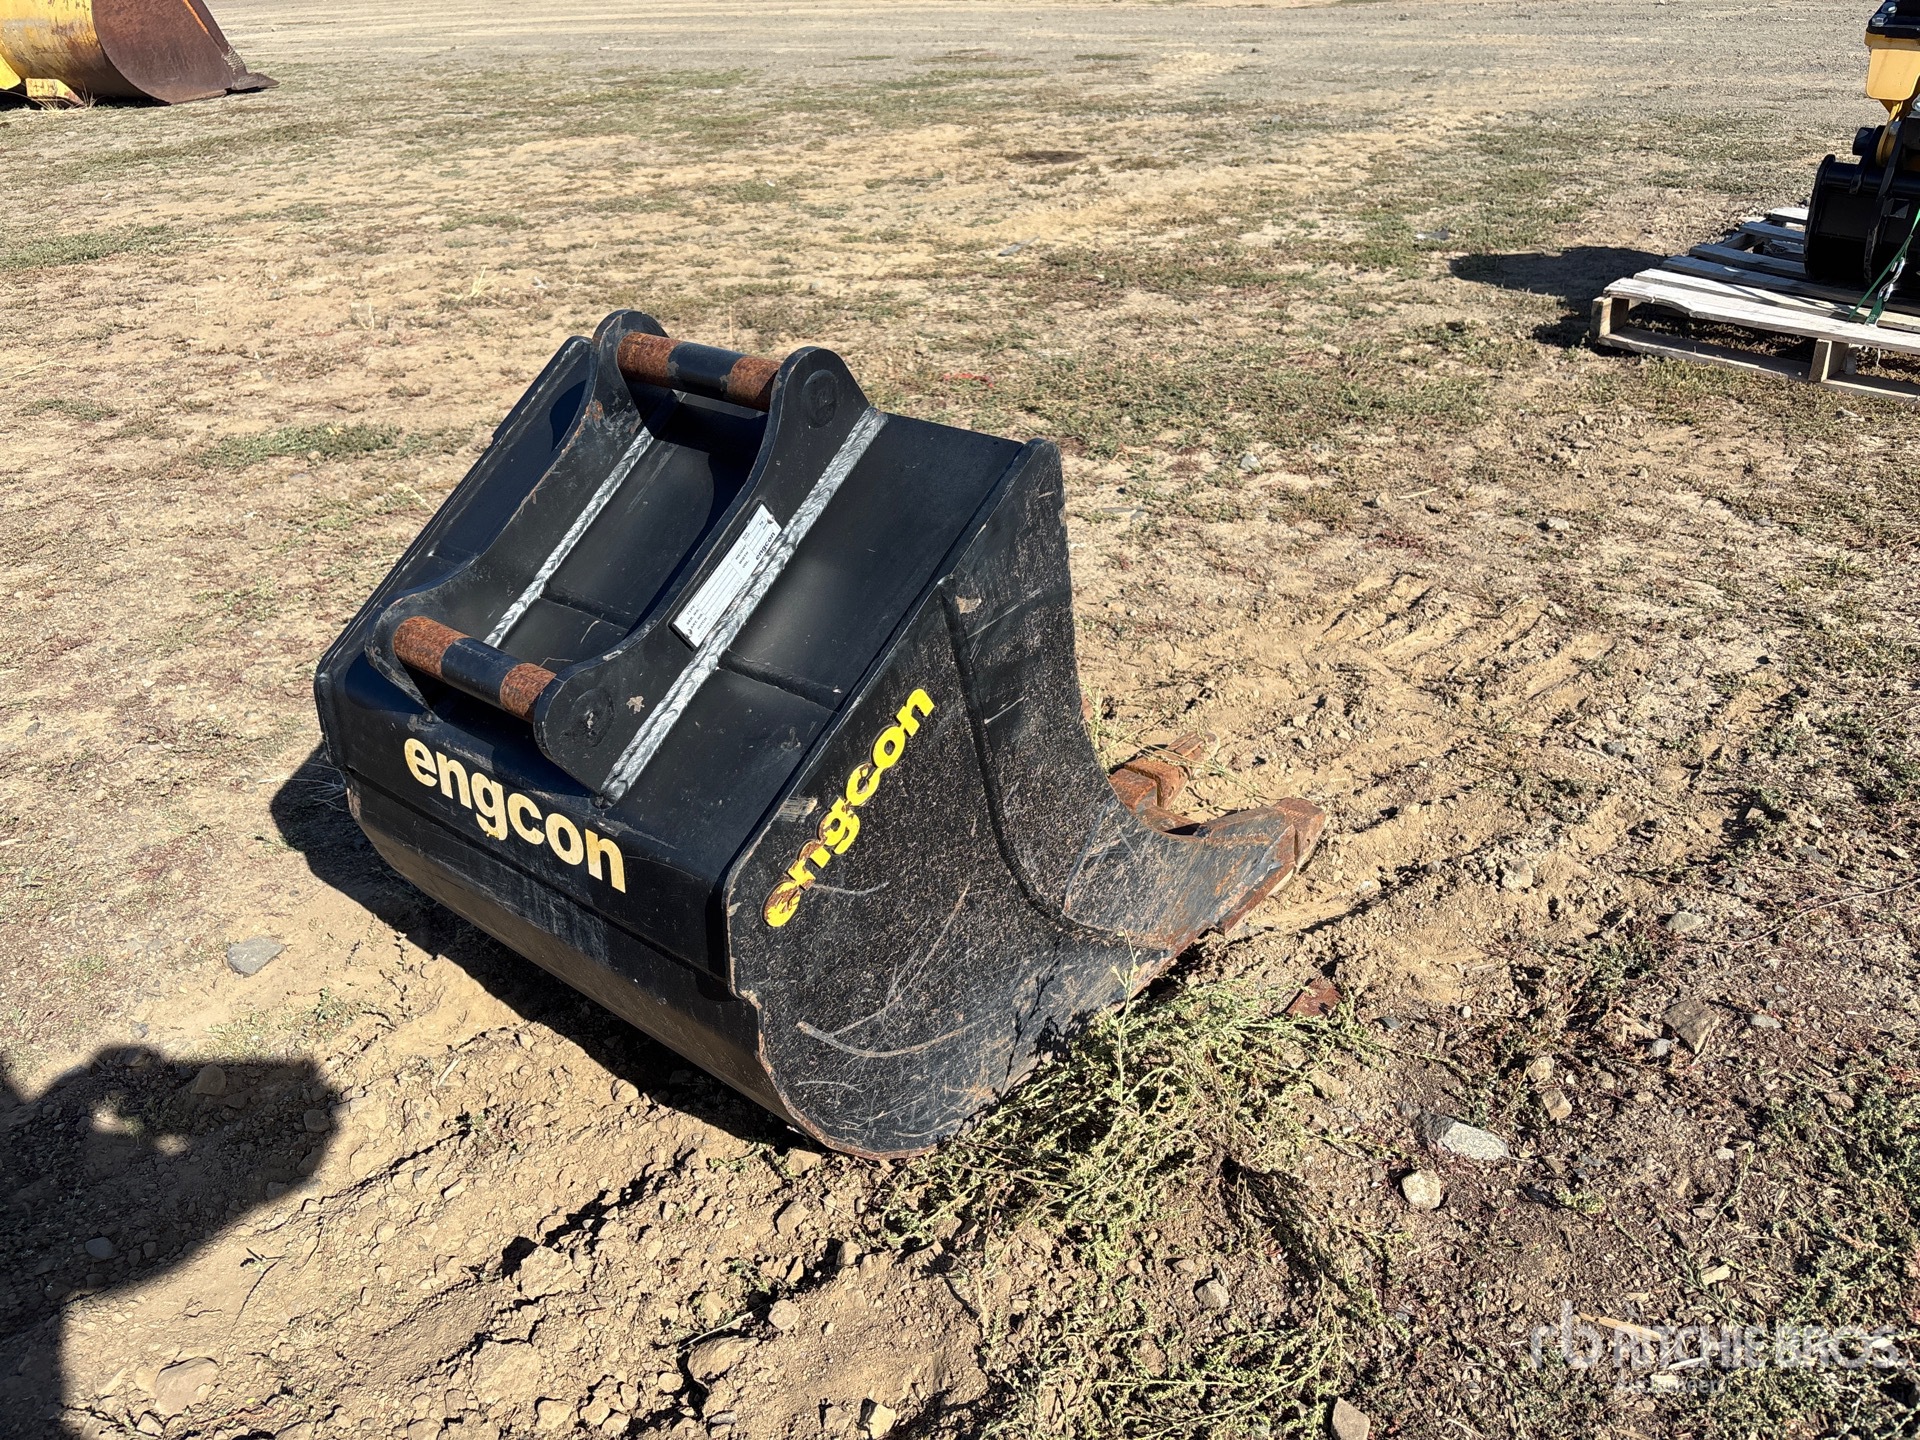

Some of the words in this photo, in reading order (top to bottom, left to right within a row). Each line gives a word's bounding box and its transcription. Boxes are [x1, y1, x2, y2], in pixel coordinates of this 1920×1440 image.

[755, 532, 776, 561] engcon
[404, 738, 626, 893] engcon
[762, 688, 935, 928] engcon
